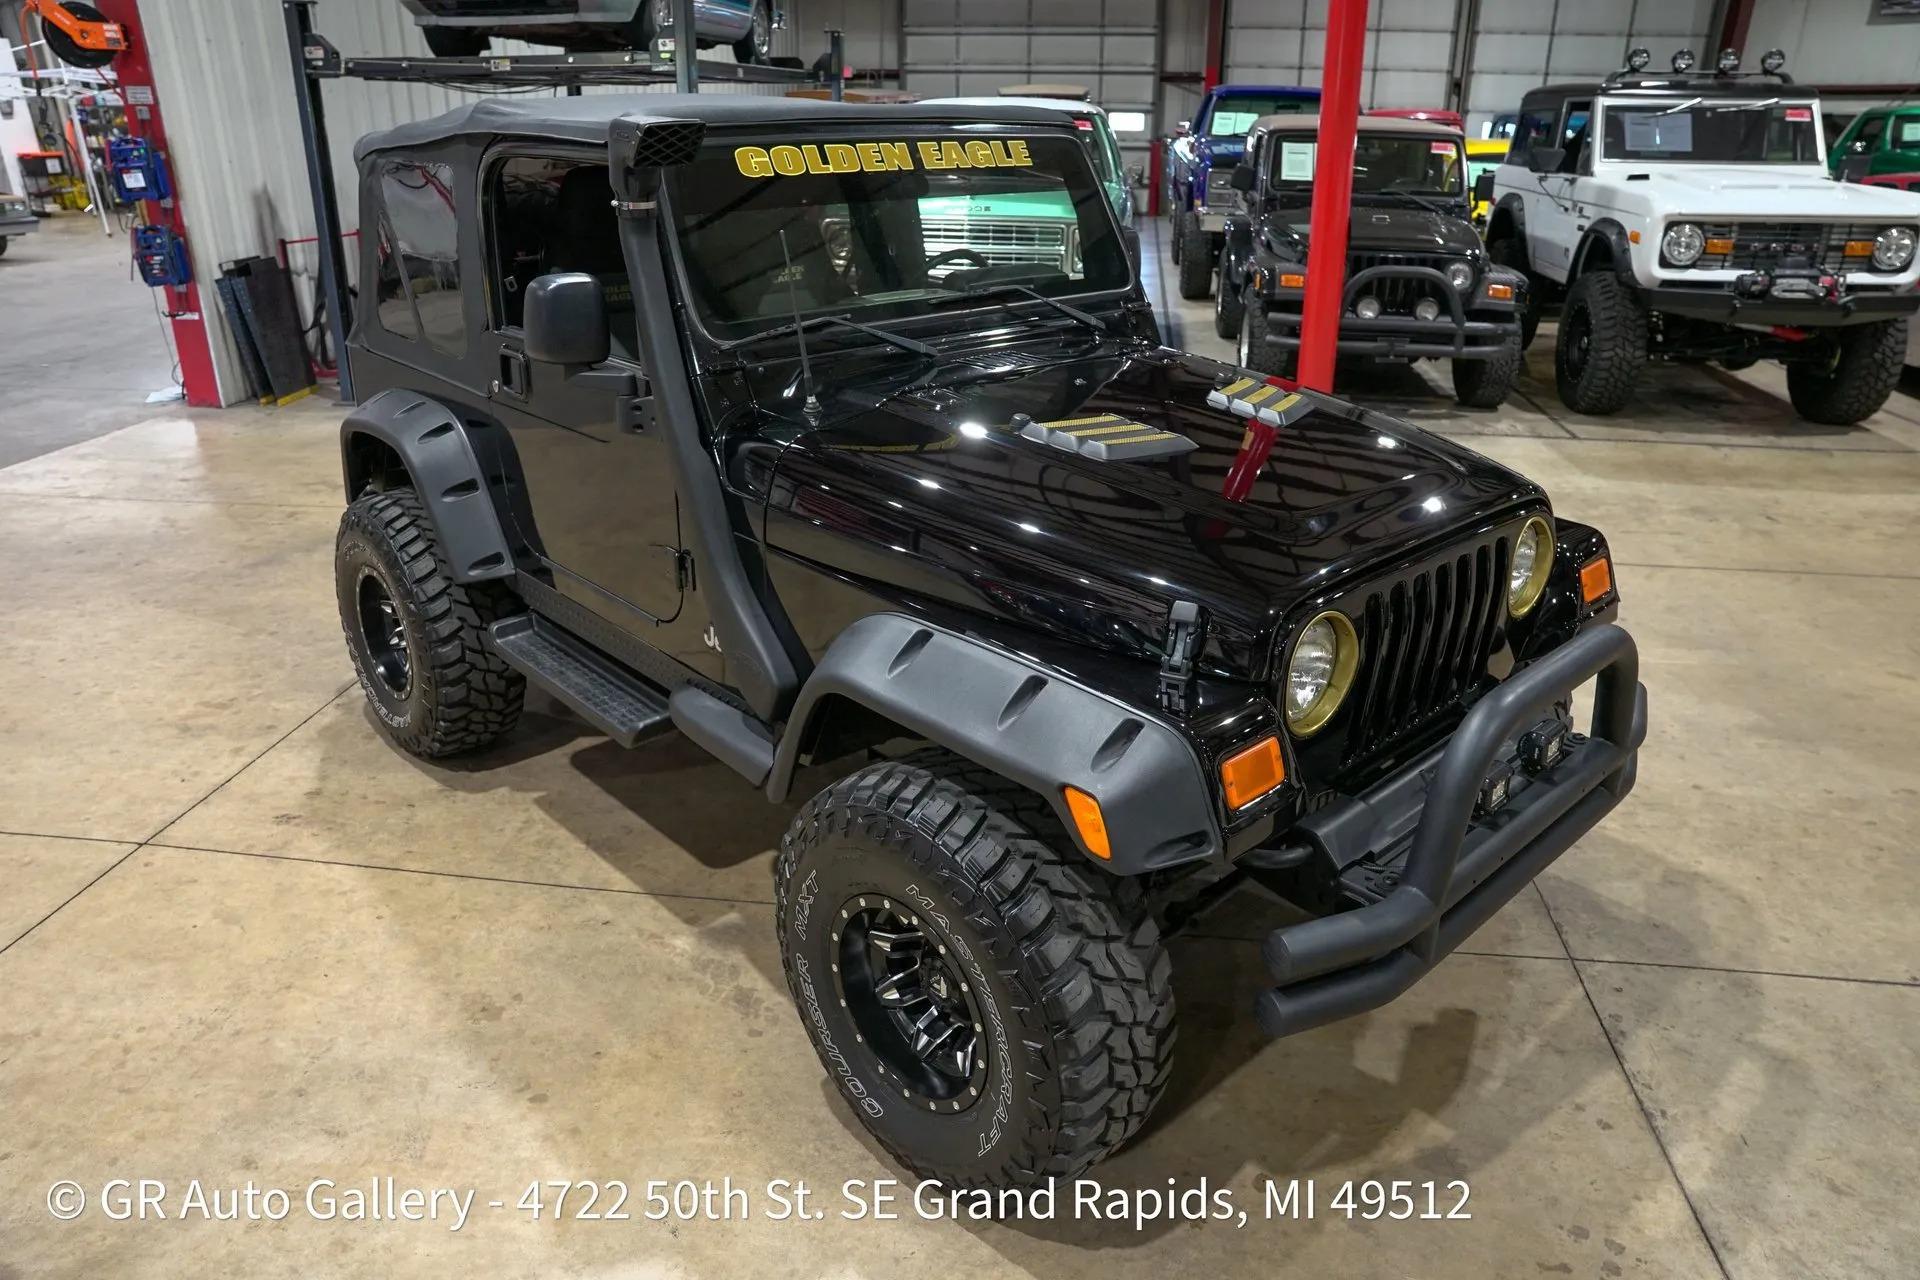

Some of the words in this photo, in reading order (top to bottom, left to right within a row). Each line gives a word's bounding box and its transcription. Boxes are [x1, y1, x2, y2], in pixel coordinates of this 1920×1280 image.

[734, 142, 914, 178] GOLDEN
[916, 140, 1033, 170] EAGLE
[794, 869, 819, 942] MXT
[795, 952, 884, 1119] COURSER
[905, 883, 1013, 1158] MASTERCRAFT
